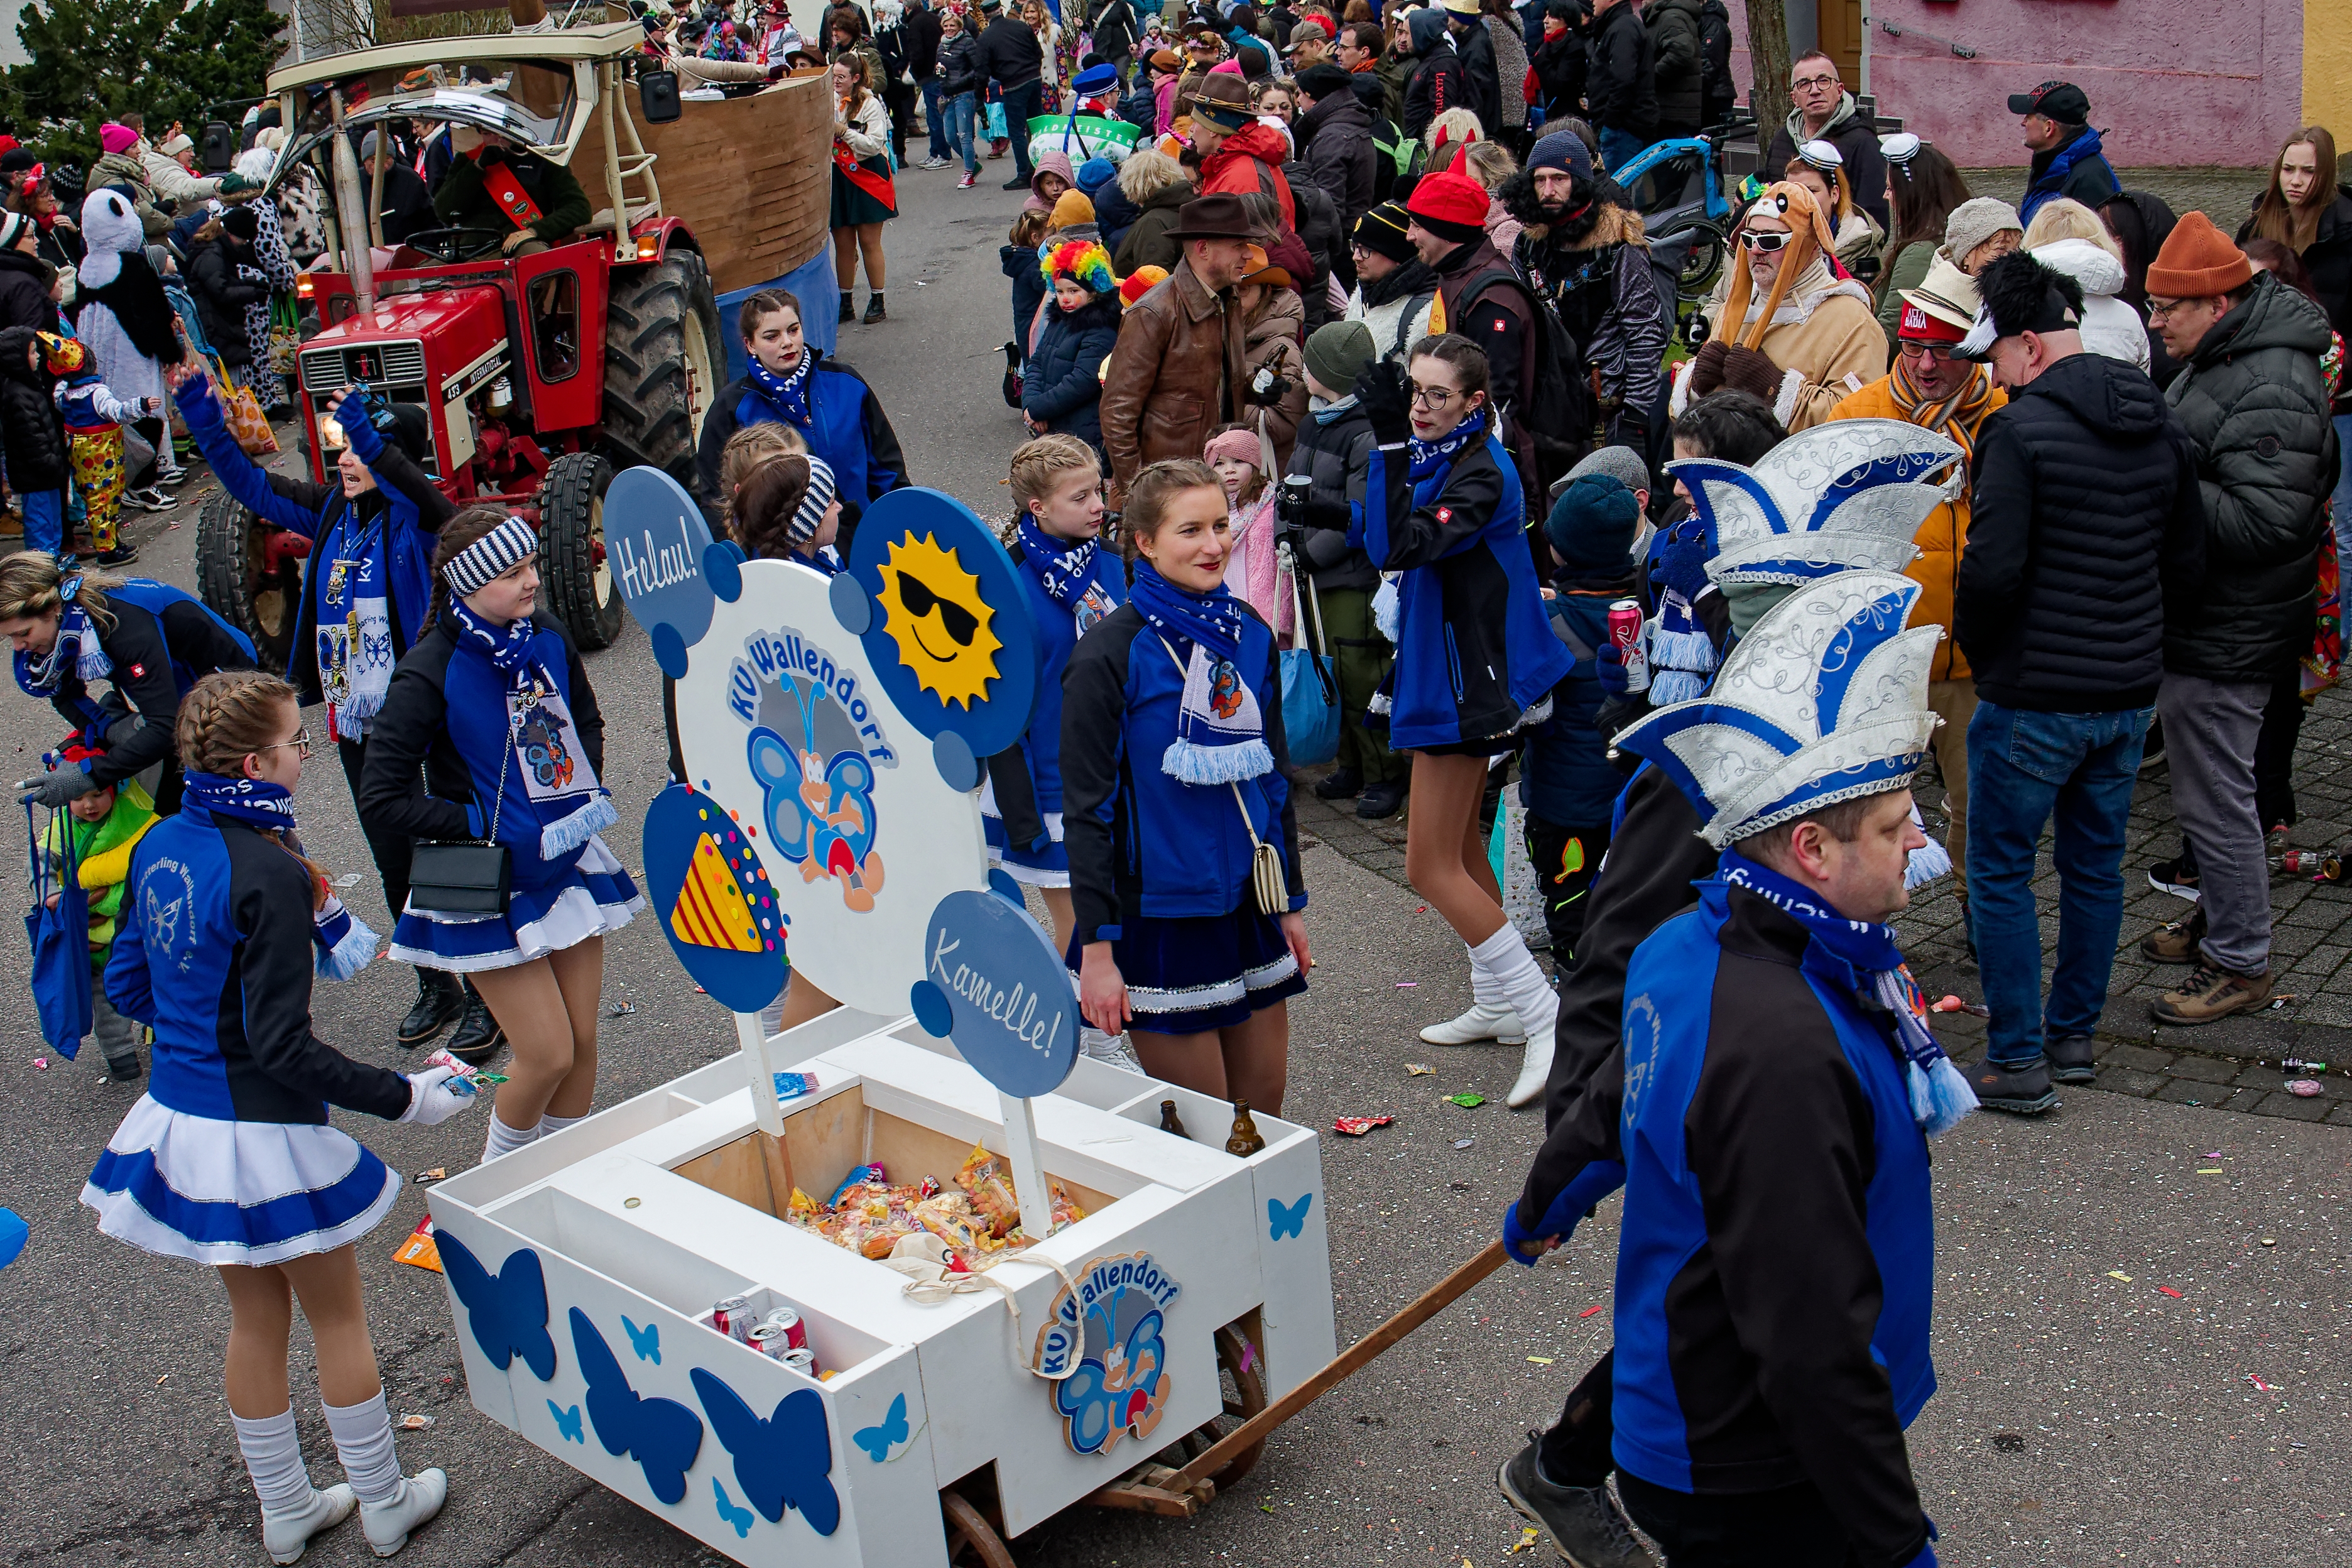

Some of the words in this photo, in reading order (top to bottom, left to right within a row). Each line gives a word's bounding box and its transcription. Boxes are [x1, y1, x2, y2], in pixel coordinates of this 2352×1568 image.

[1435, 72, 1446, 116] Luxemb
[447, 383, 460, 400] 433
[614, 515, 698, 599] Helau!
[749, 634, 893, 760] Wallendorf
[180, 863, 197, 945] Wallendorf
[930, 927, 1063, 1058] Kamelle!
[1060, 1260, 1178, 1322] Wallendorf
